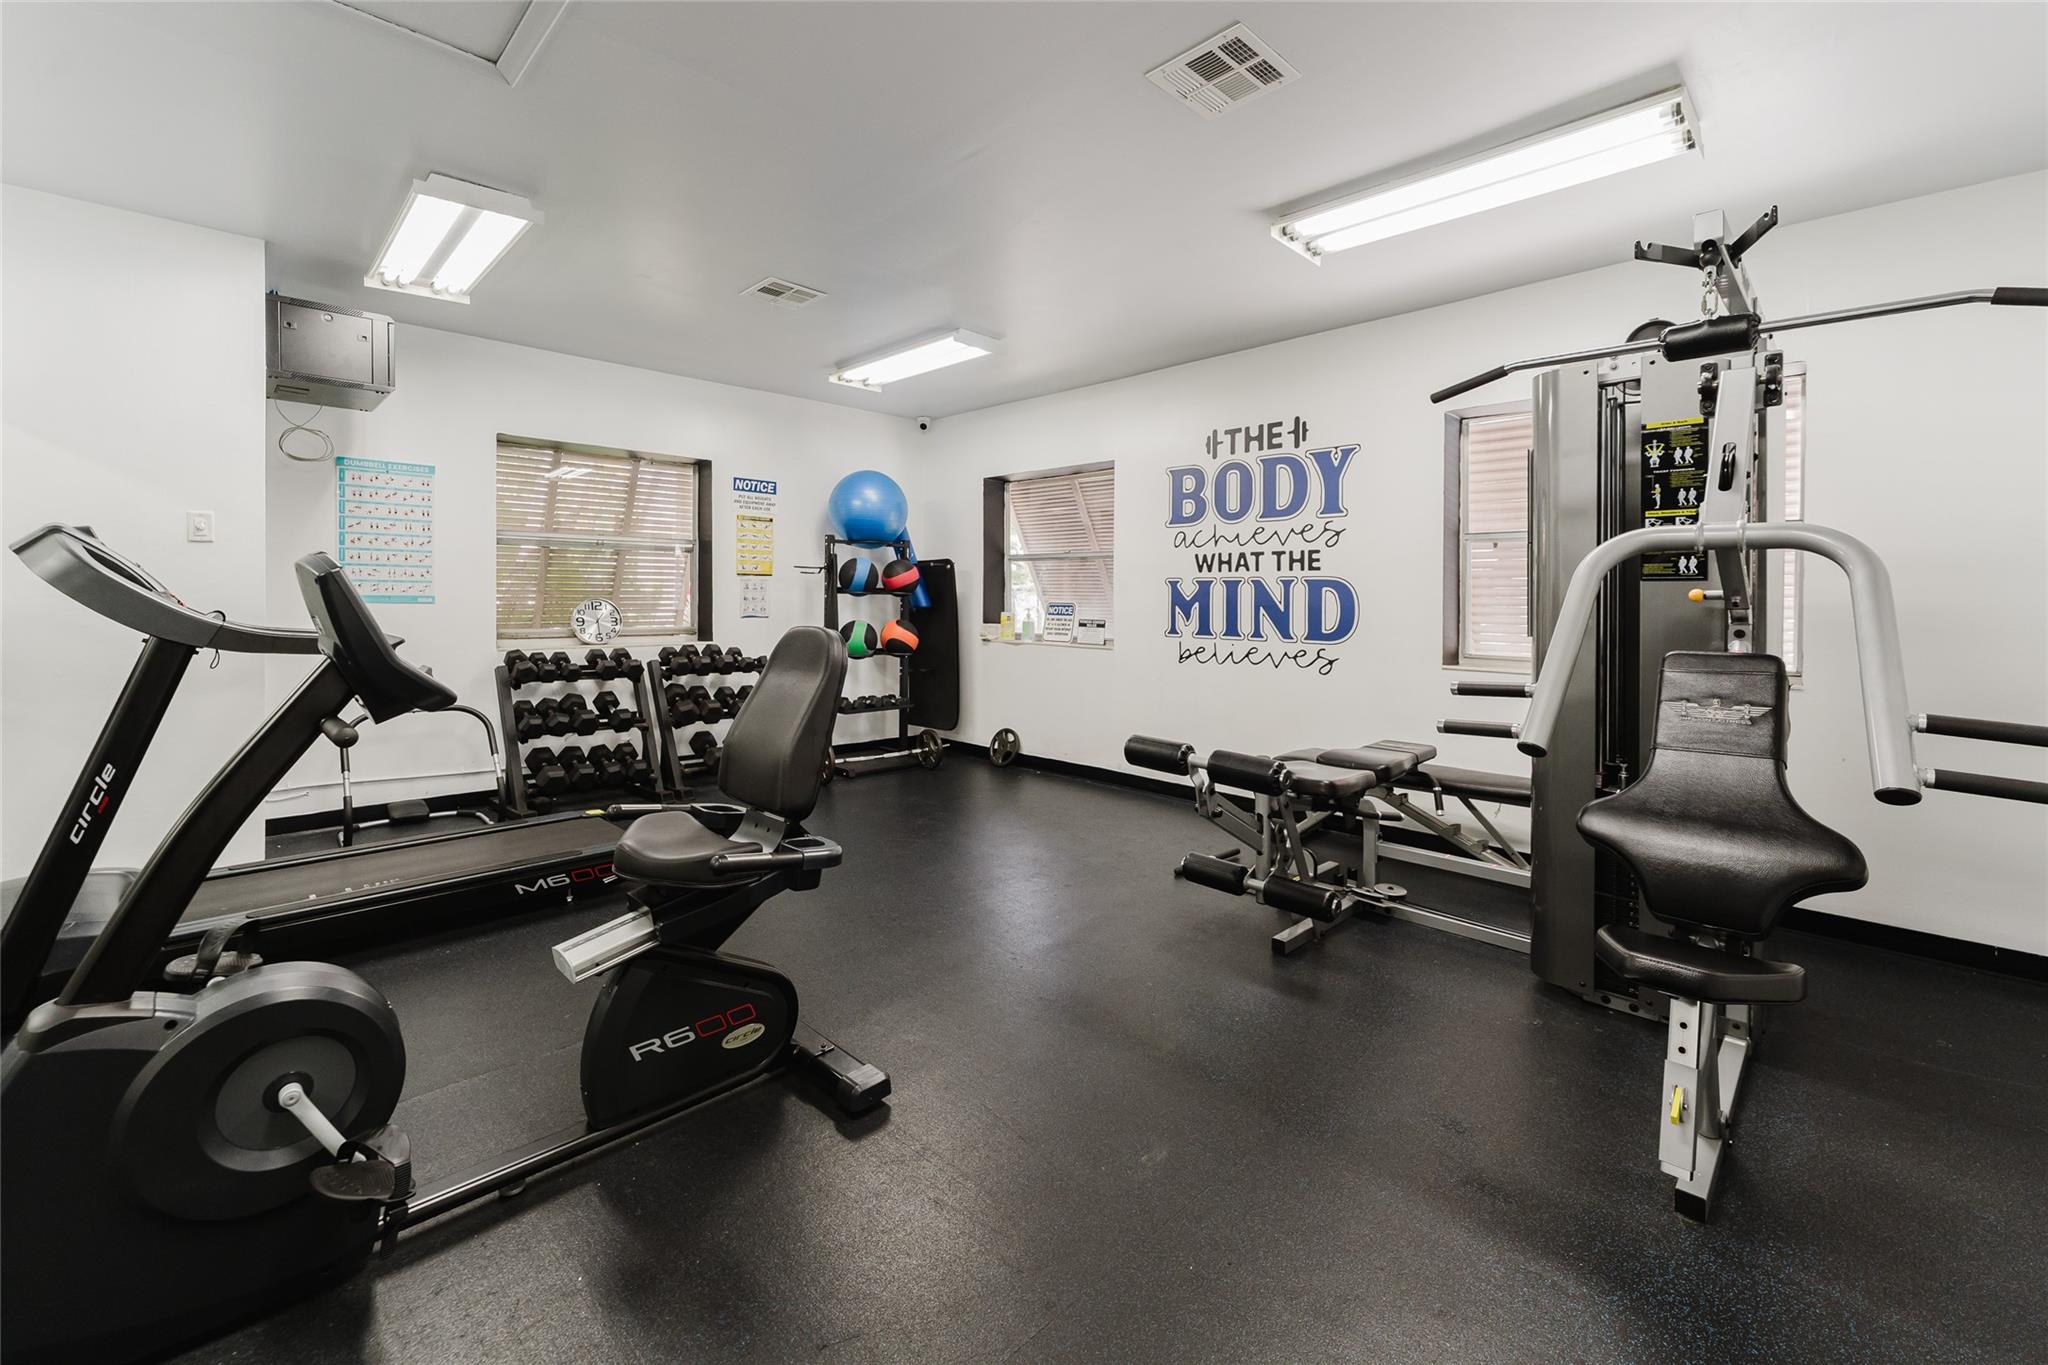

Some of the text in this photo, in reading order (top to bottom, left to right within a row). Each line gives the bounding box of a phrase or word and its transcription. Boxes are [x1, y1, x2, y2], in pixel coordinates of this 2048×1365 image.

[1224, 421, 1283, 455] THE
[387, 463, 430, 473] EXERCISES
[735, 479, 775, 493] NOTICE
[1165, 443, 1361, 529] BODY
[1174, 520, 1346, 548] achieves
[1195, 550, 1321, 573] WHAT THE
[590, 601, 602, 611] 12
[1047, 606, 1075, 616] NOTICE
[1164, 576, 1360, 645] MIND
[575, 617, 585, 627] 9
[610, 616, 618, 627] 3
[595, 632, 604, 642] 6
[1178, 641, 1340, 675] believes
[69, 763, 117, 845] circle
[628, 1003, 757, 1062] R600
